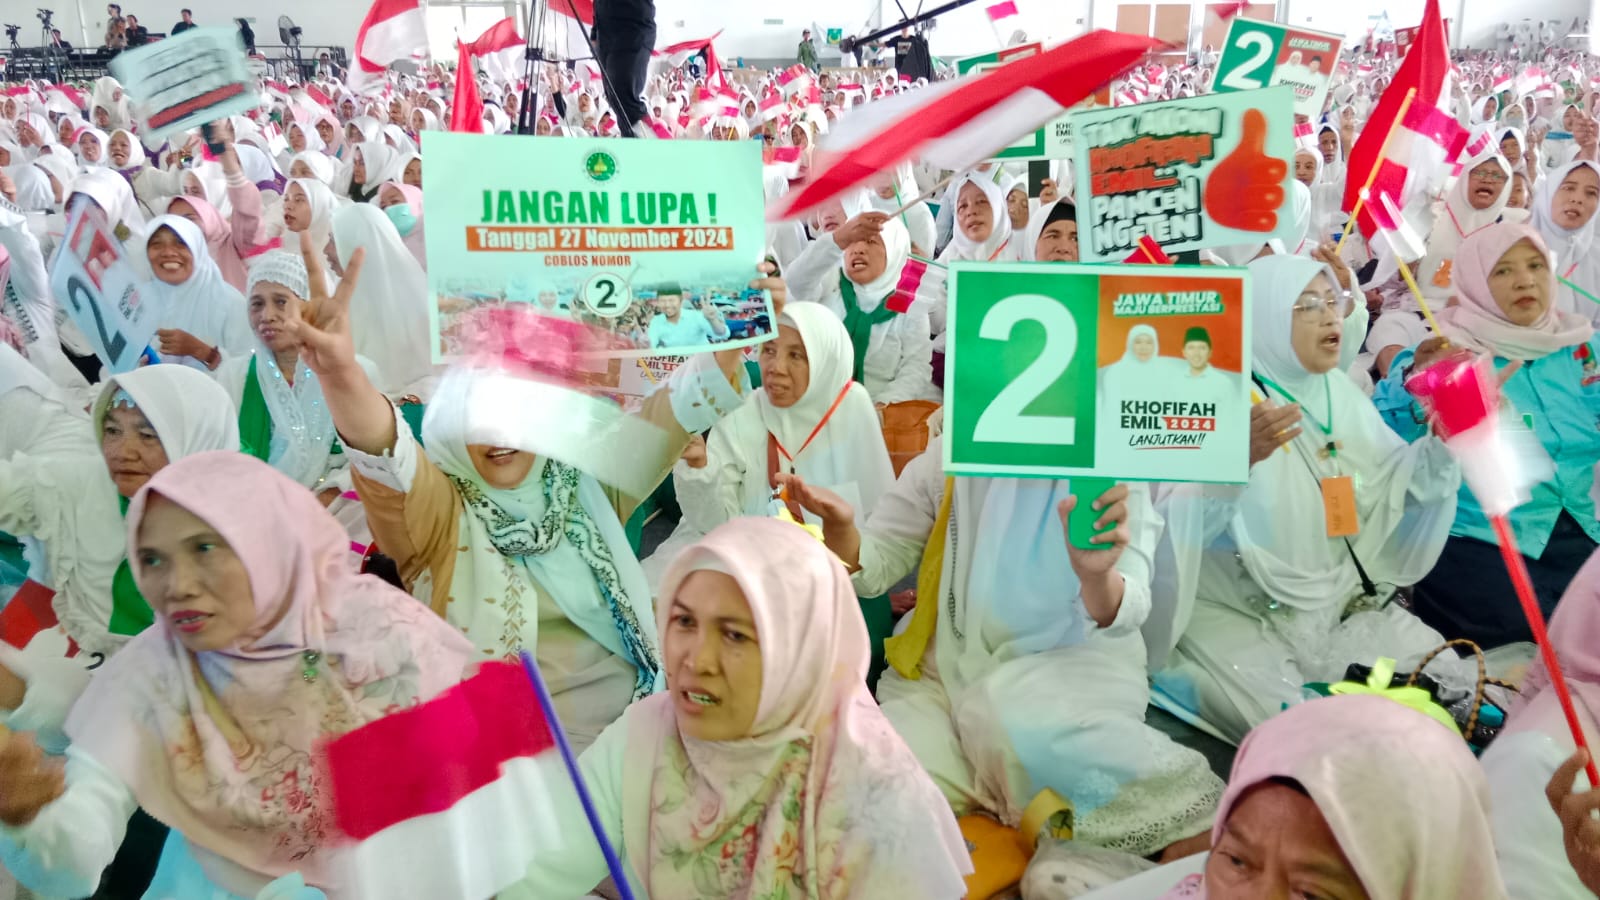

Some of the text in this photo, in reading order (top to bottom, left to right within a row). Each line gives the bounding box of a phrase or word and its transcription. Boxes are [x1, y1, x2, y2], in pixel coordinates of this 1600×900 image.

[1221, 31, 1273, 90] 2
[481, 190, 609, 224] JANGAN
[621, 192, 699, 224] LUPA
[1091, 176, 1200, 224] PANCEN
[476, 228, 728, 251] Tanggal 27 November 2024
[1092, 213, 1202, 255] NGETEN
[544, 255, 631, 267] COBLOS NOMOR
[595, 279, 617, 309] 2
[1113, 290, 1219, 306] JAWA TIMUR
[67, 274, 127, 367] 2
[1113, 302, 1221, 315] MAJU BERPRESTASI
[972, 294, 1077, 446] 2
[1121, 400, 1216, 416] KHOFIFAH
[1120, 415, 1212, 430] EMIL 2024
[1128, 432, 1207, 447] LANJUTKAN!!
